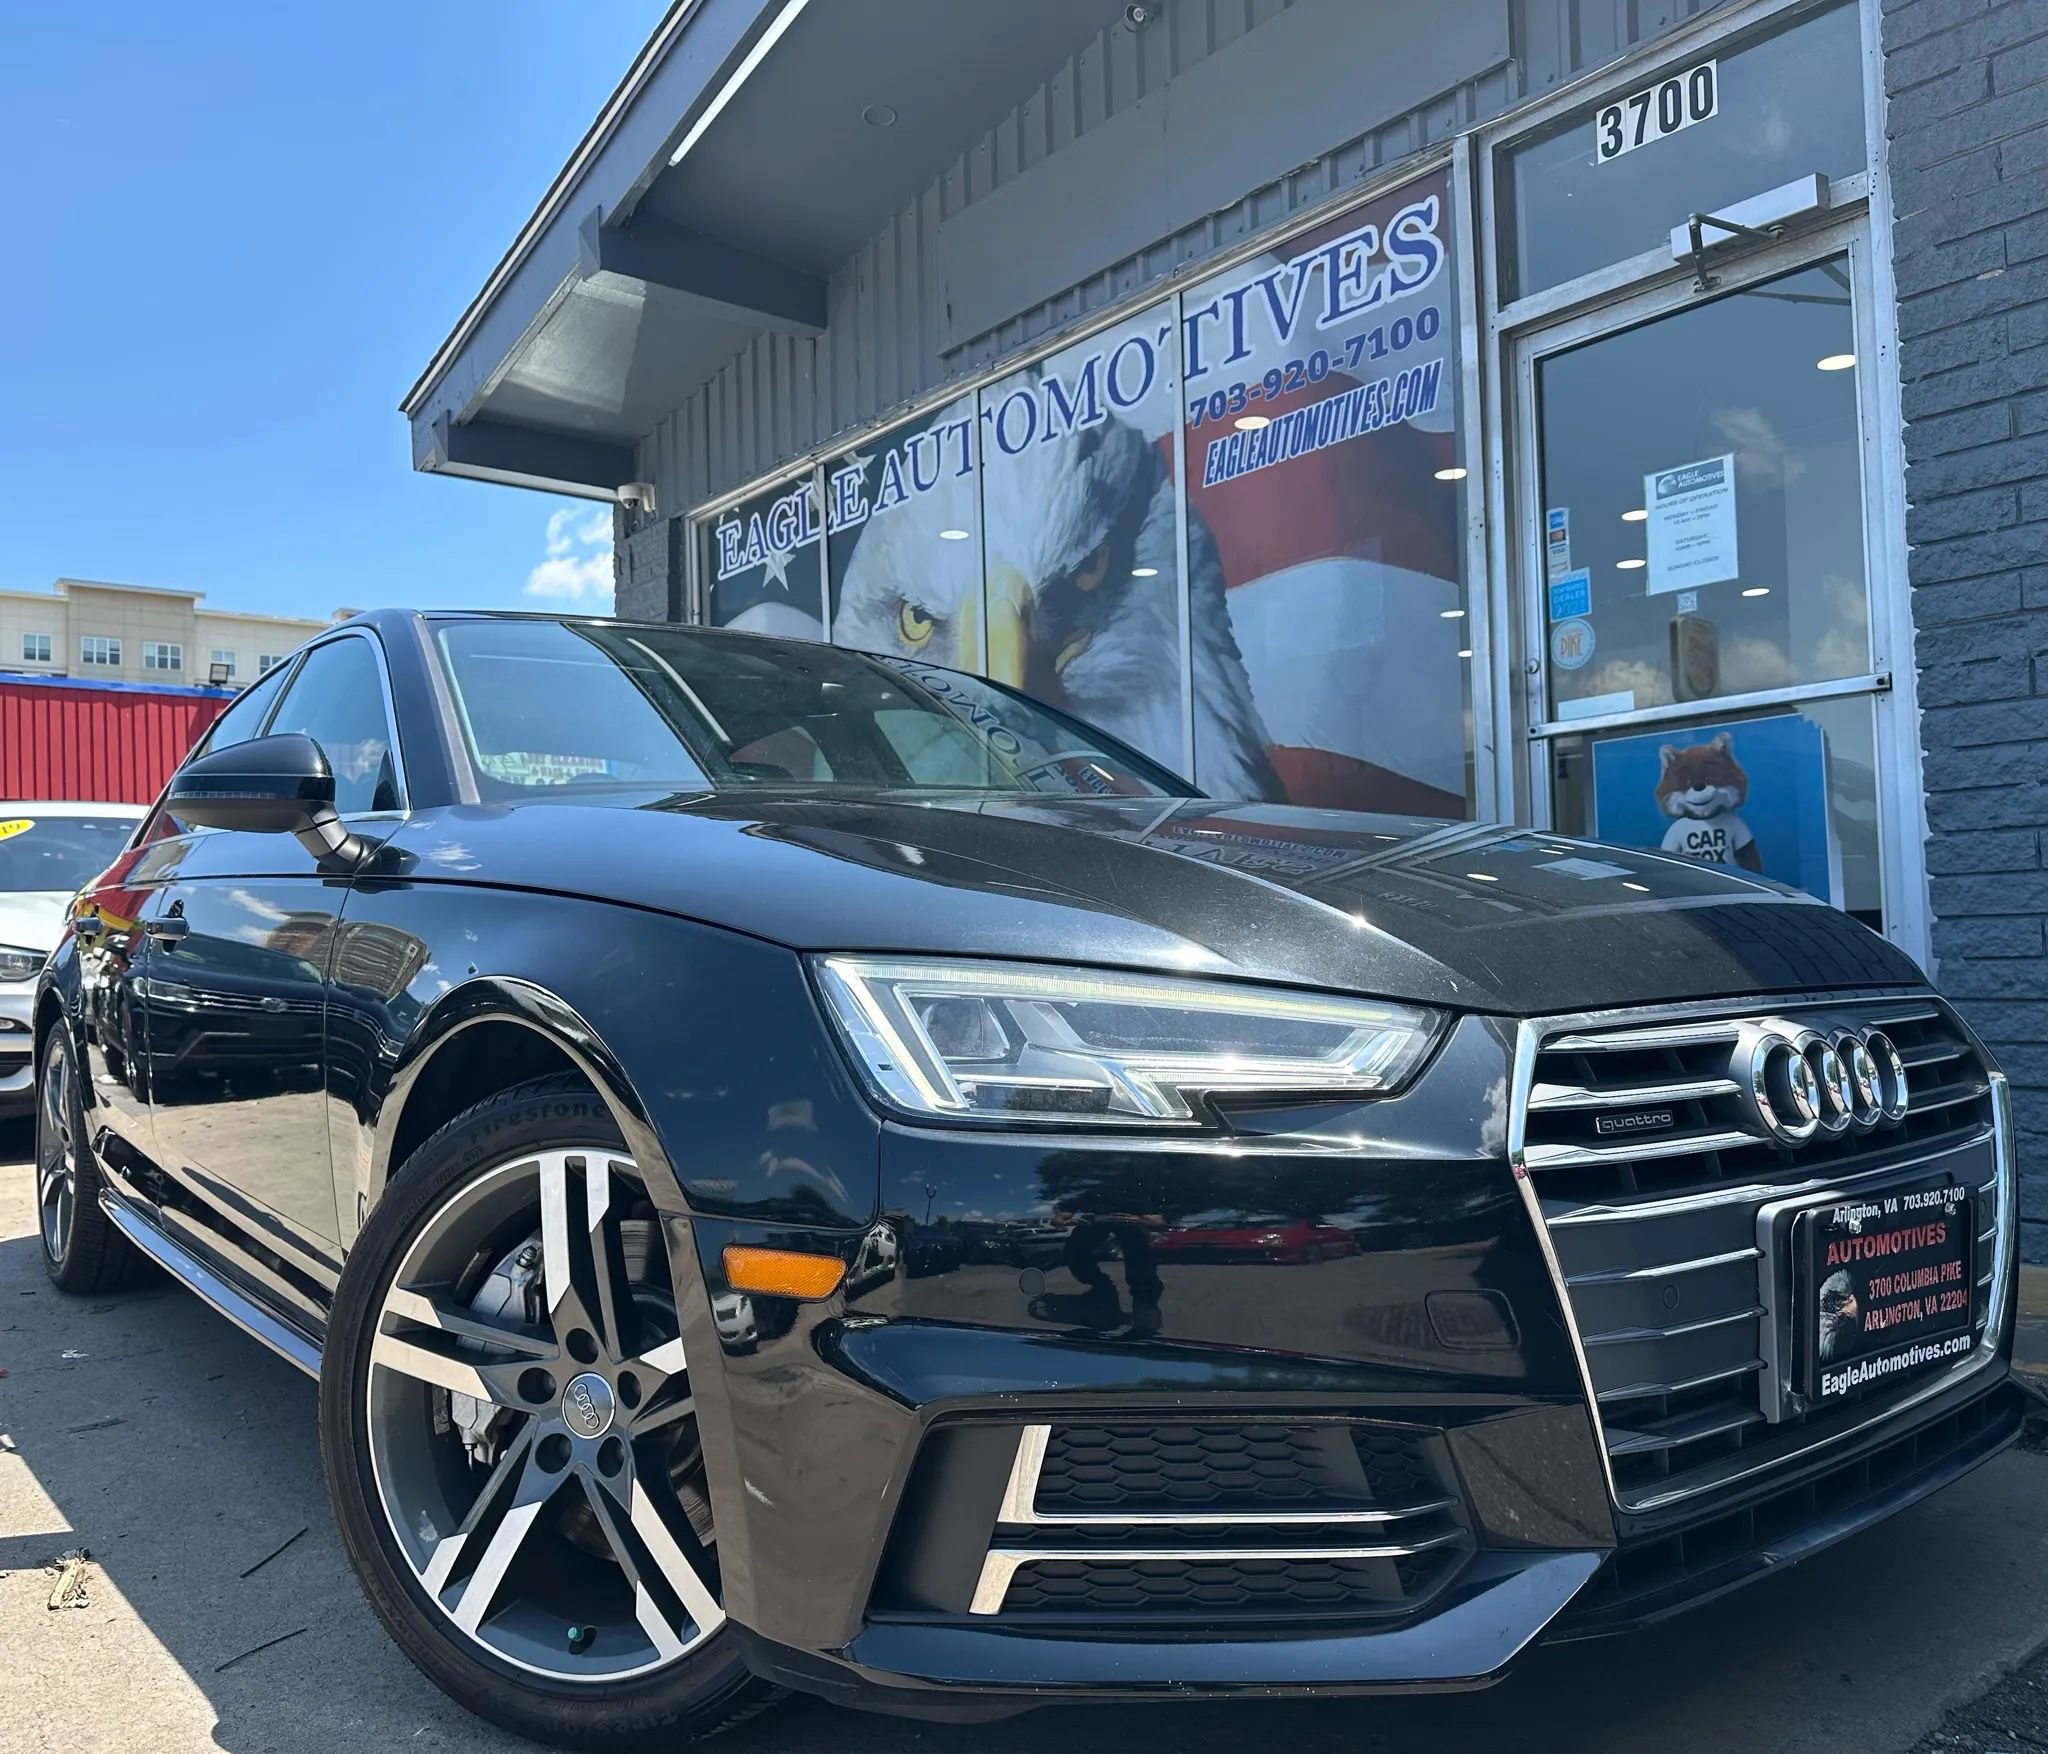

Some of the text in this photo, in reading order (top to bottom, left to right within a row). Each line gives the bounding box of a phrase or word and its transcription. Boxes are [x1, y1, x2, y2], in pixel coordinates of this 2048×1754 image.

[1601, 66, 1713, 158] 3700
[717, 199, 1441, 578] EAGLE AUTOMOTIVES
[1190, 307, 1440, 429] 703-920-7100
[1204, 360, 1443, 487] EAGLEAUTOMOTIVES.COM
[1655, 500, 1678, 511] HOURS
[1689, 488, 1729, 503] OPERATION
[1678, 471, 1725, 489] AUTOMOTIVES
[1663, 511, 1689, 521] MONDAY
[1686, 828, 1726, 849] CAR
[1602, 1114, 1671, 1131] quattro
[1833, 1186, 1965, 1224] Arlington, VA 703.920.7100
[1826, 1222, 1946, 1266] AUTOMOTIVES
[1868, 1260, 1962, 1300] 3700 COLUMBIA PIKE
[1864, 1288, 1968, 1331] ARLINGTON, VA 22204
[1822, 1334, 1971, 1397] EagleAutomotives.com
